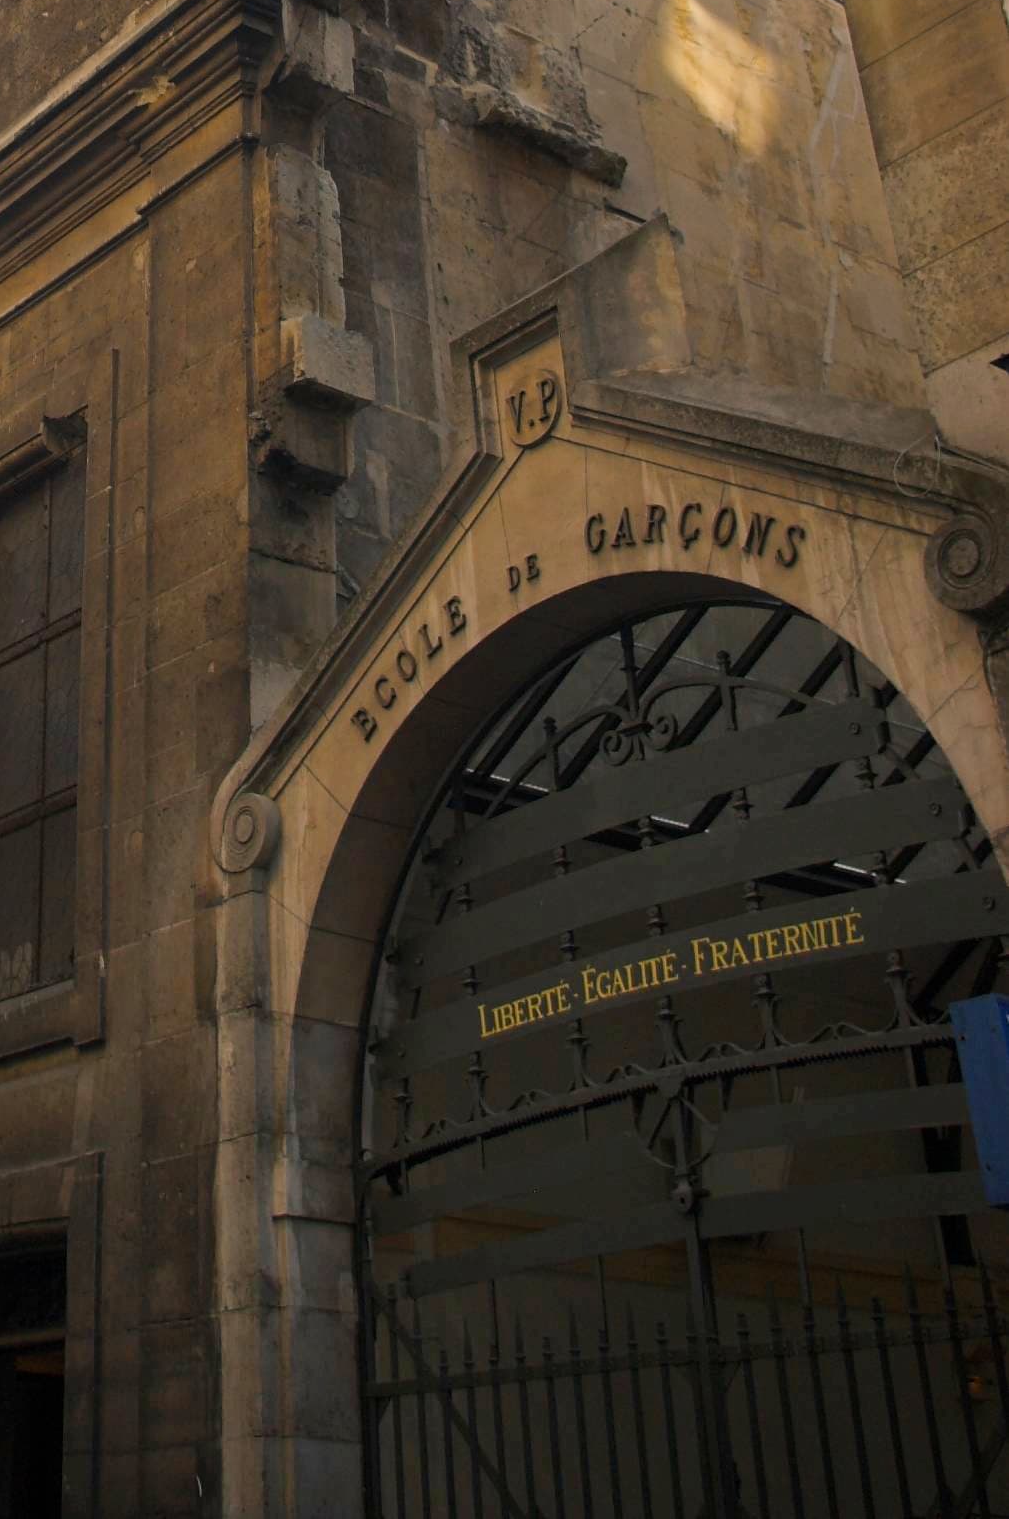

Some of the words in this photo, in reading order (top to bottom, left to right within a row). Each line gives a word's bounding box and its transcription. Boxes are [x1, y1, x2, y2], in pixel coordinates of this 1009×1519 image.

[350, 595, 468, 743] ECOLE
[506, 553, 541, 592] DE
[584, 502, 806, 569] GARÇONS
[477, 979, 571, 1039] LIBERTÉ
[580, 949, 679, 1005] ÉGALITÉ
[690, 906, 864, 976] FRATERNITÉ
